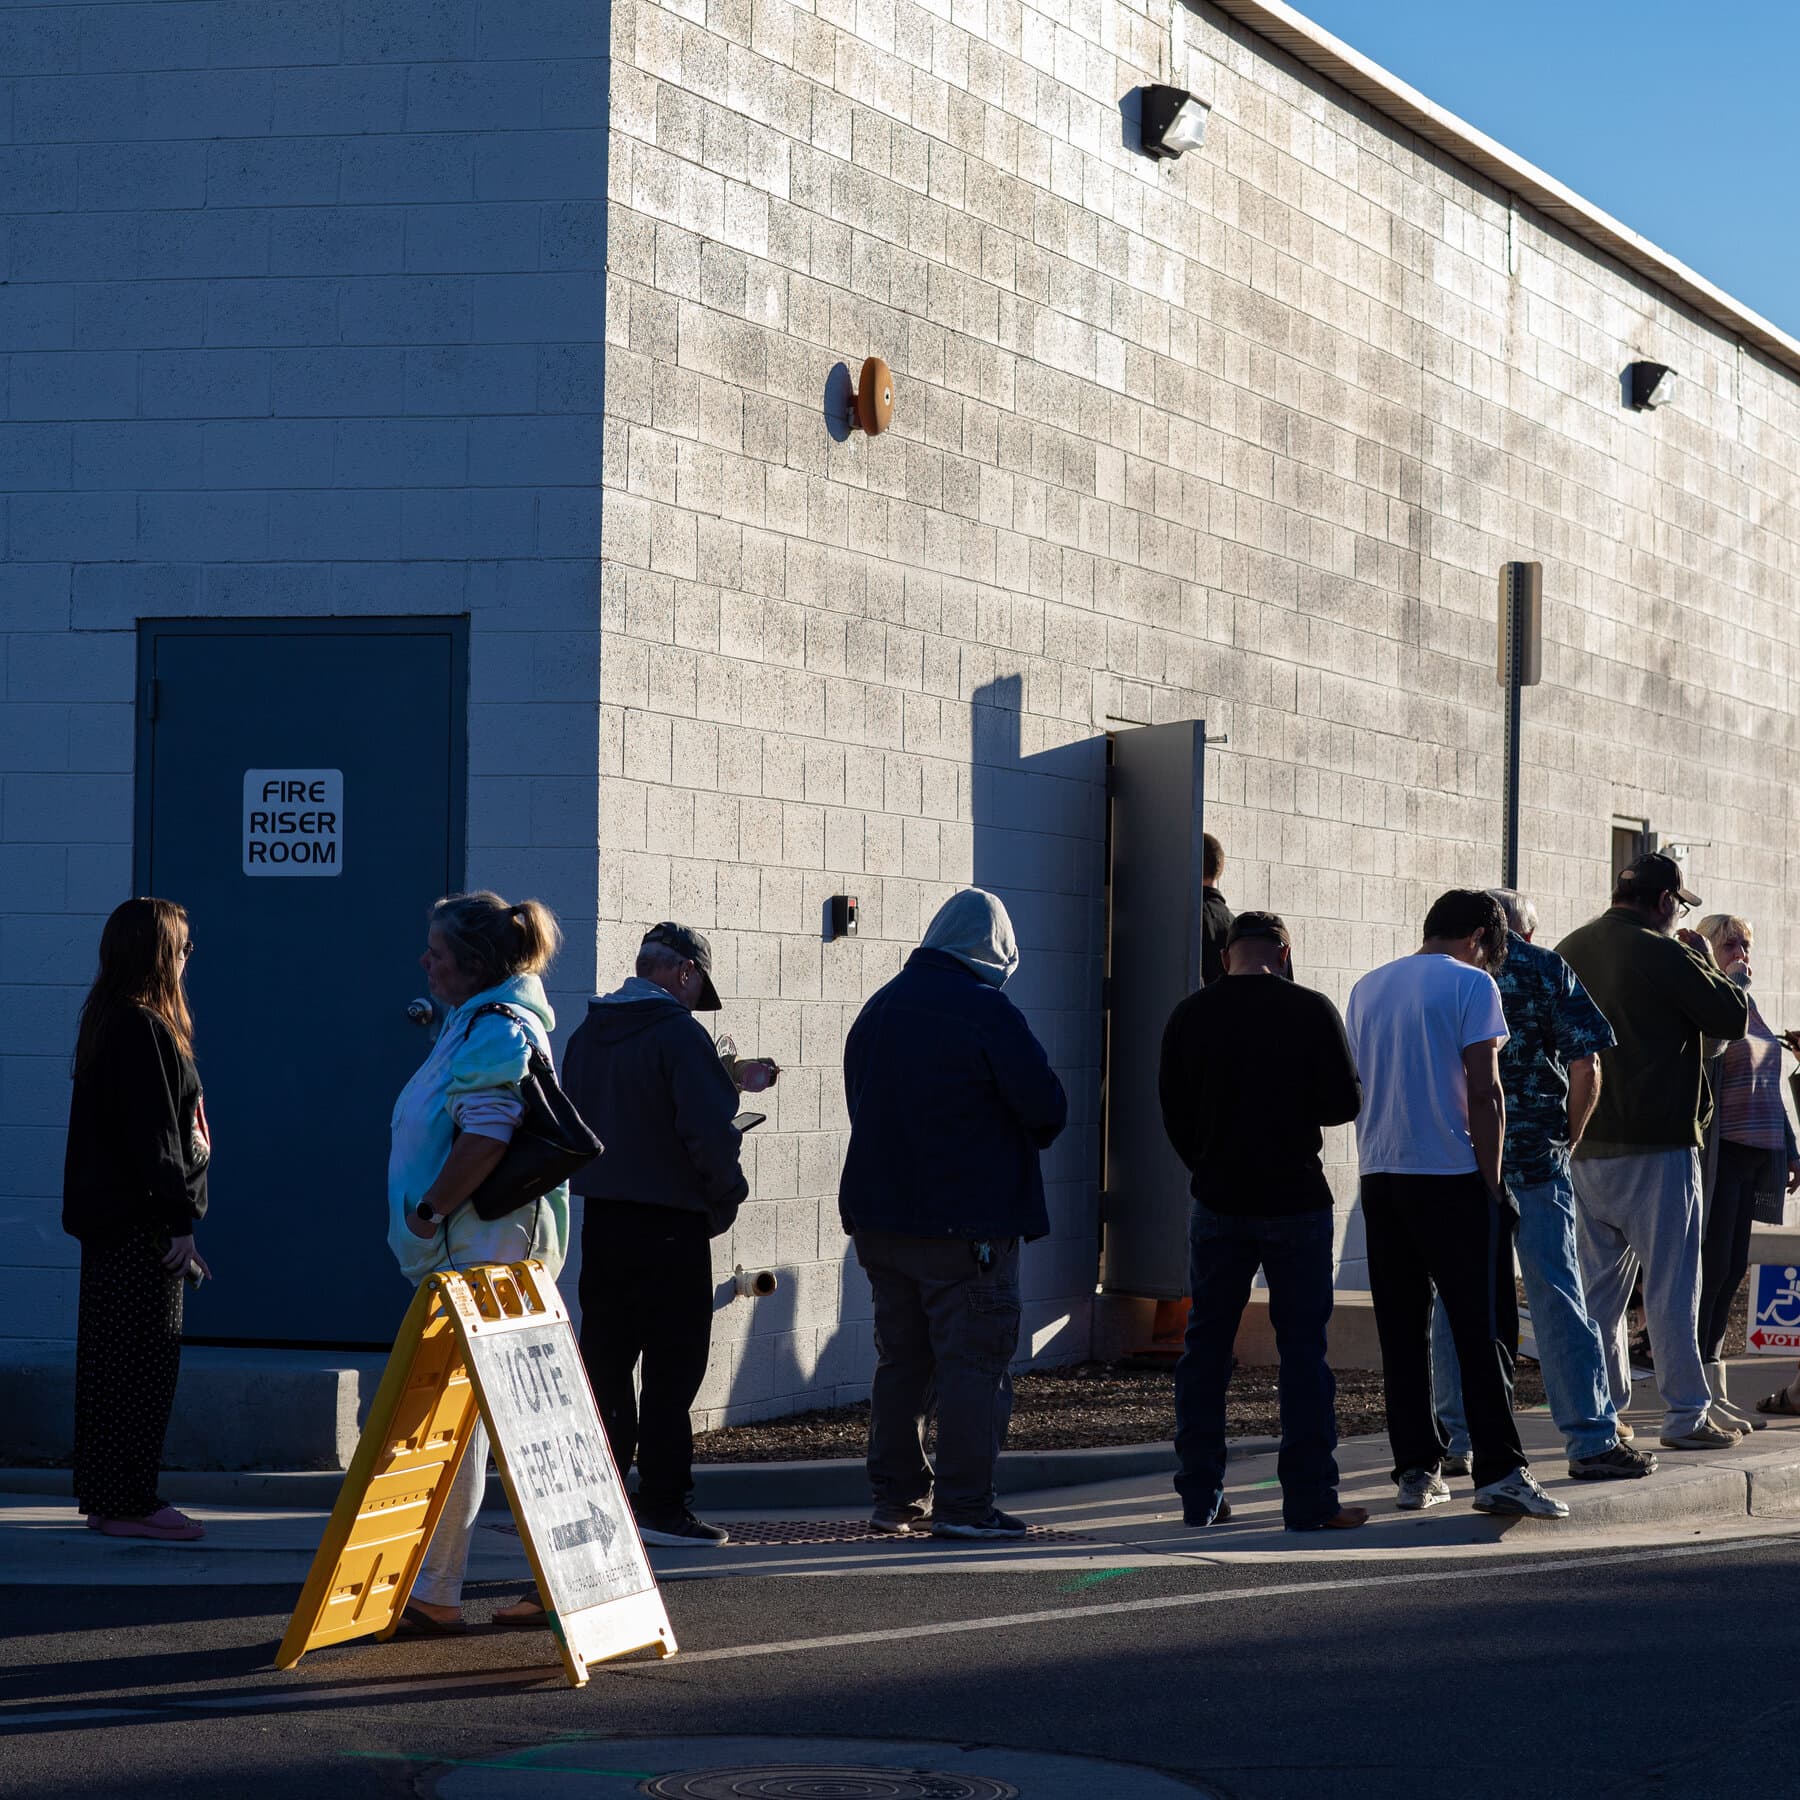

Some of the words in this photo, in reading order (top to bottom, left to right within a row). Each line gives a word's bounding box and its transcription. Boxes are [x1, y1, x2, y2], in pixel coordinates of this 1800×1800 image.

[263, 781, 325, 803] FIRE
[250, 812, 336, 834] RISER
[249, 842, 336, 863] ROOM
[1764, 1334, 1800, 1346] VOT
[495, 1343, 572, 1415] VOTE
